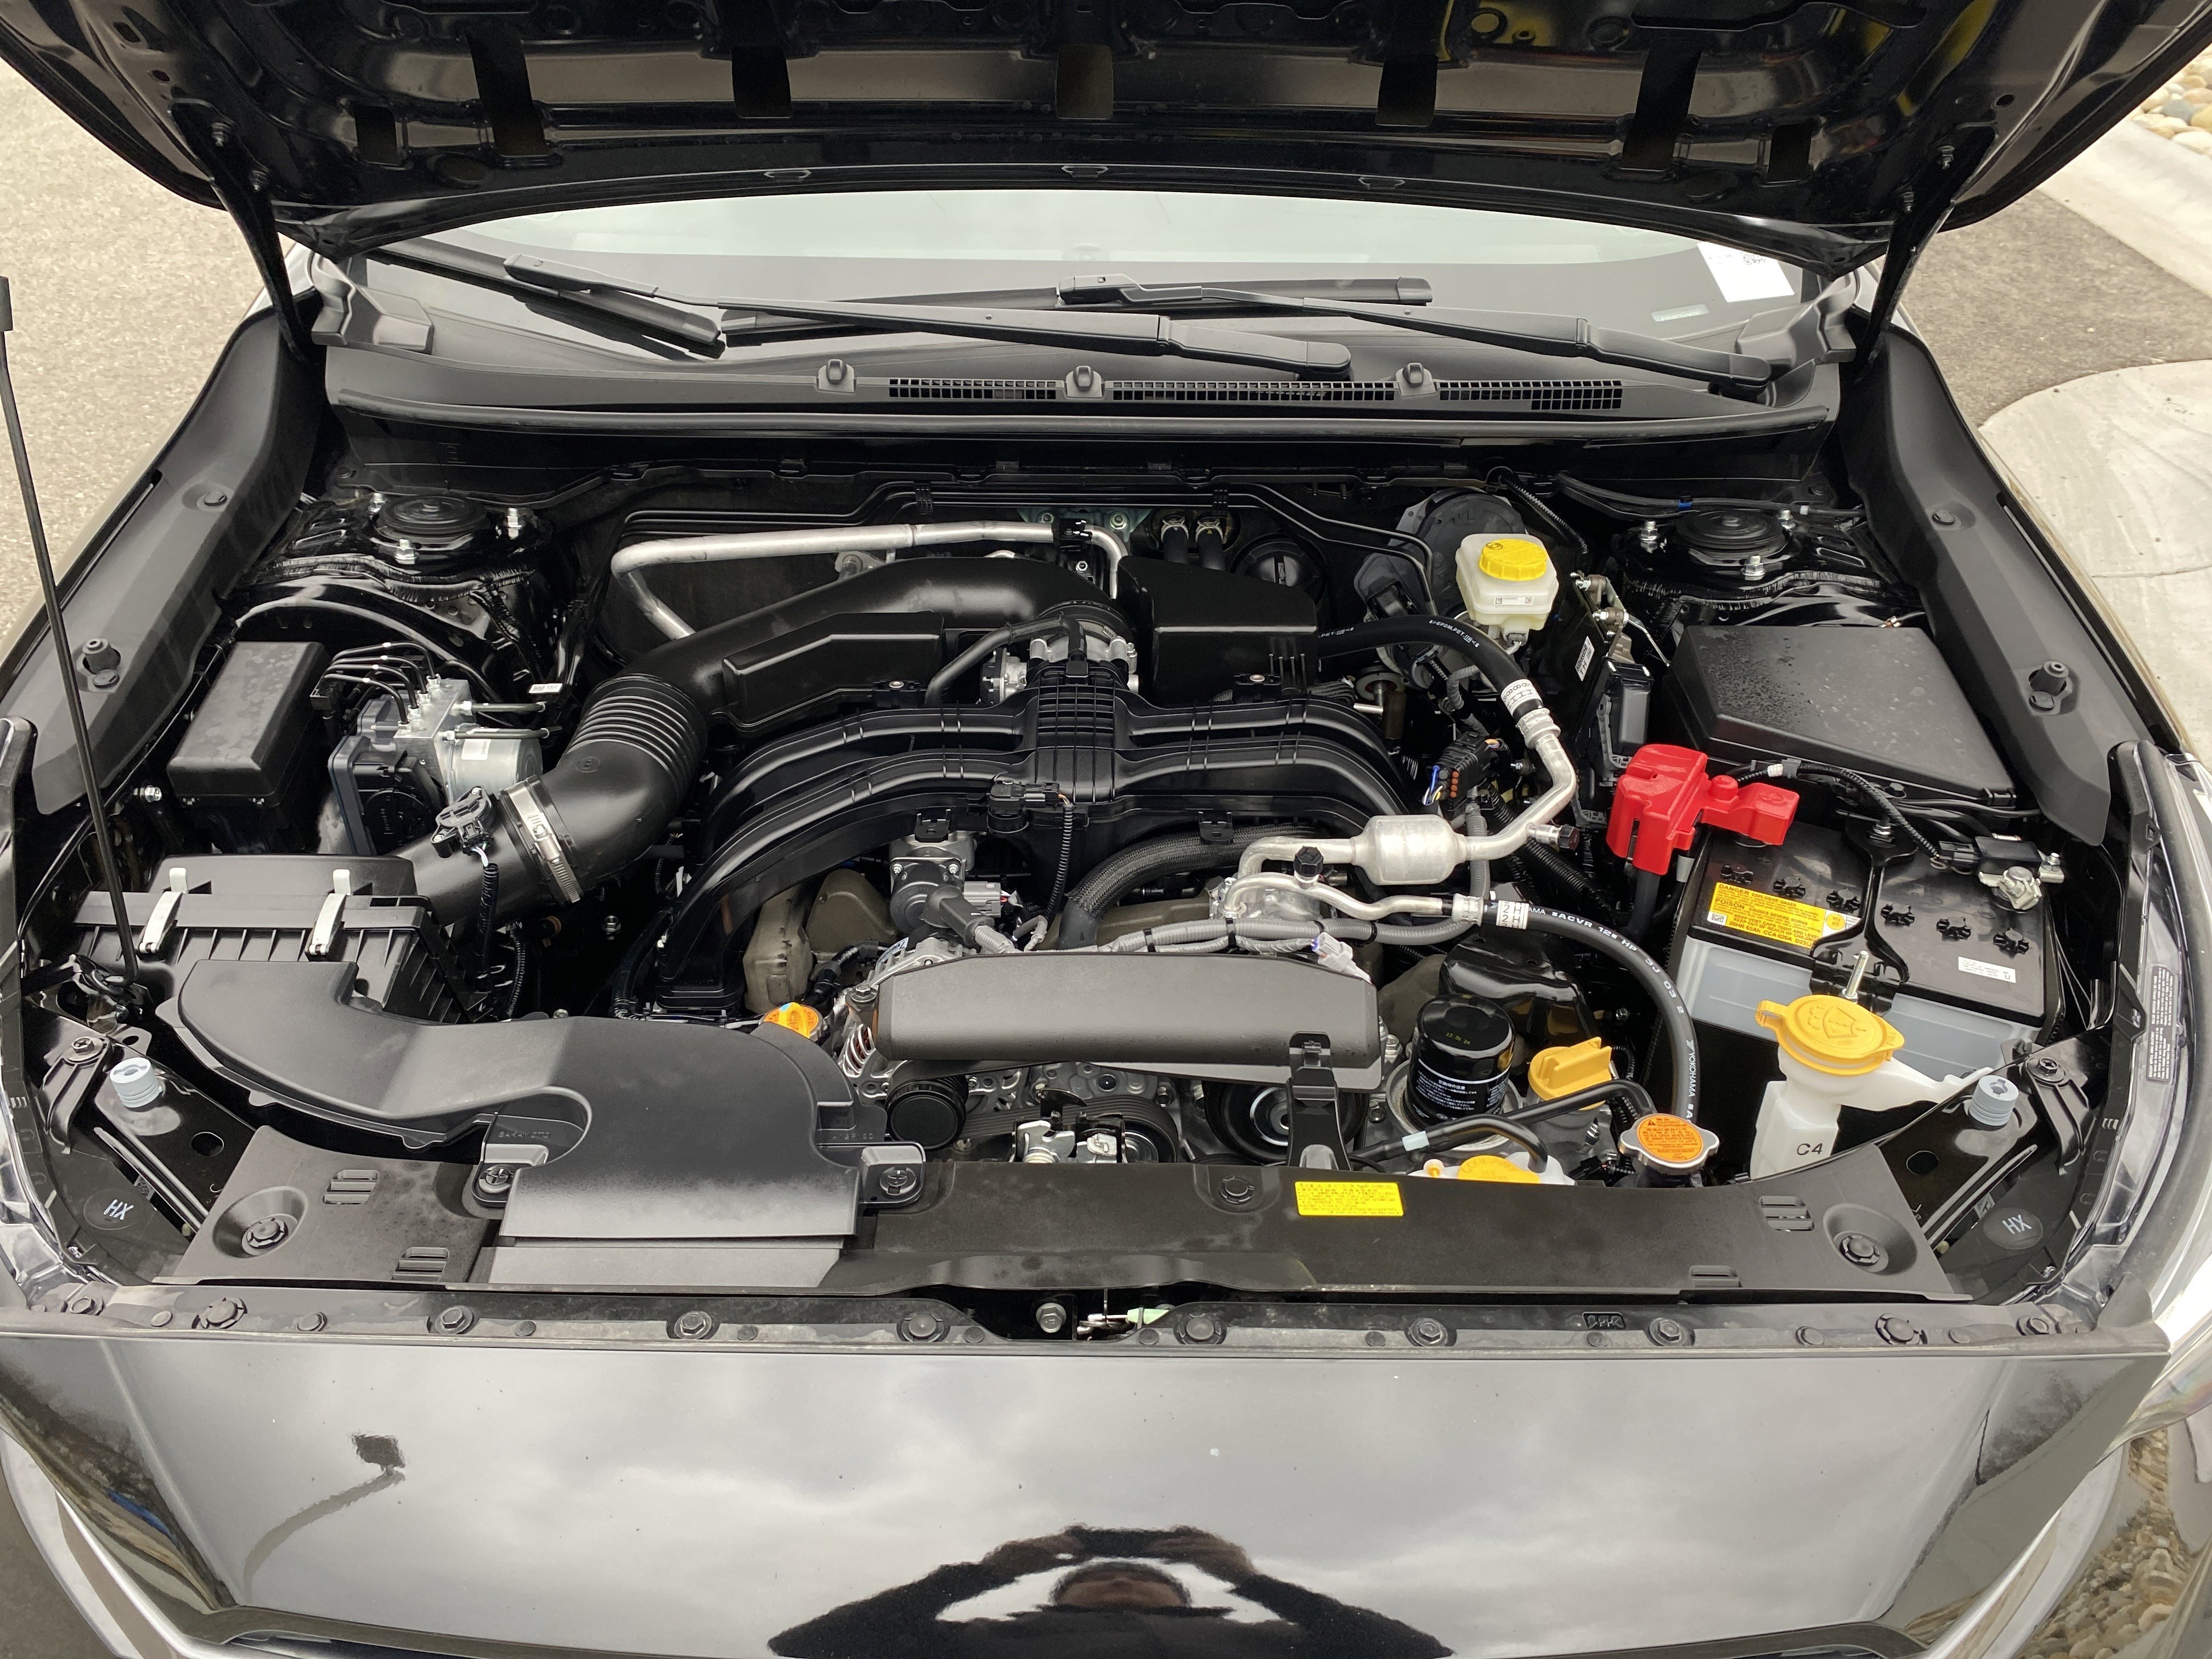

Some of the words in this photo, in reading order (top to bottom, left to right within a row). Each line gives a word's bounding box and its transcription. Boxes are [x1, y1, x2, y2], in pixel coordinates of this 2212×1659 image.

[1719, 884, 1750, 895] DANGER
[1752, 893, 1779, 903] EXPLOSIVE
[1716, 898, 1745, 910] POISON
[1749, 907, 1769, 916] CAUSES
[1770, 912, 1790, 921] SEVERE
[1791, 918, 1808, 926] BURNS
[1621, 940, 1637, 951] HP
[1797, 1143, 1822, 1155] C4
[104, 1199, 134, 1220] HX
[2002, 1214, 2032, 1234] HX
